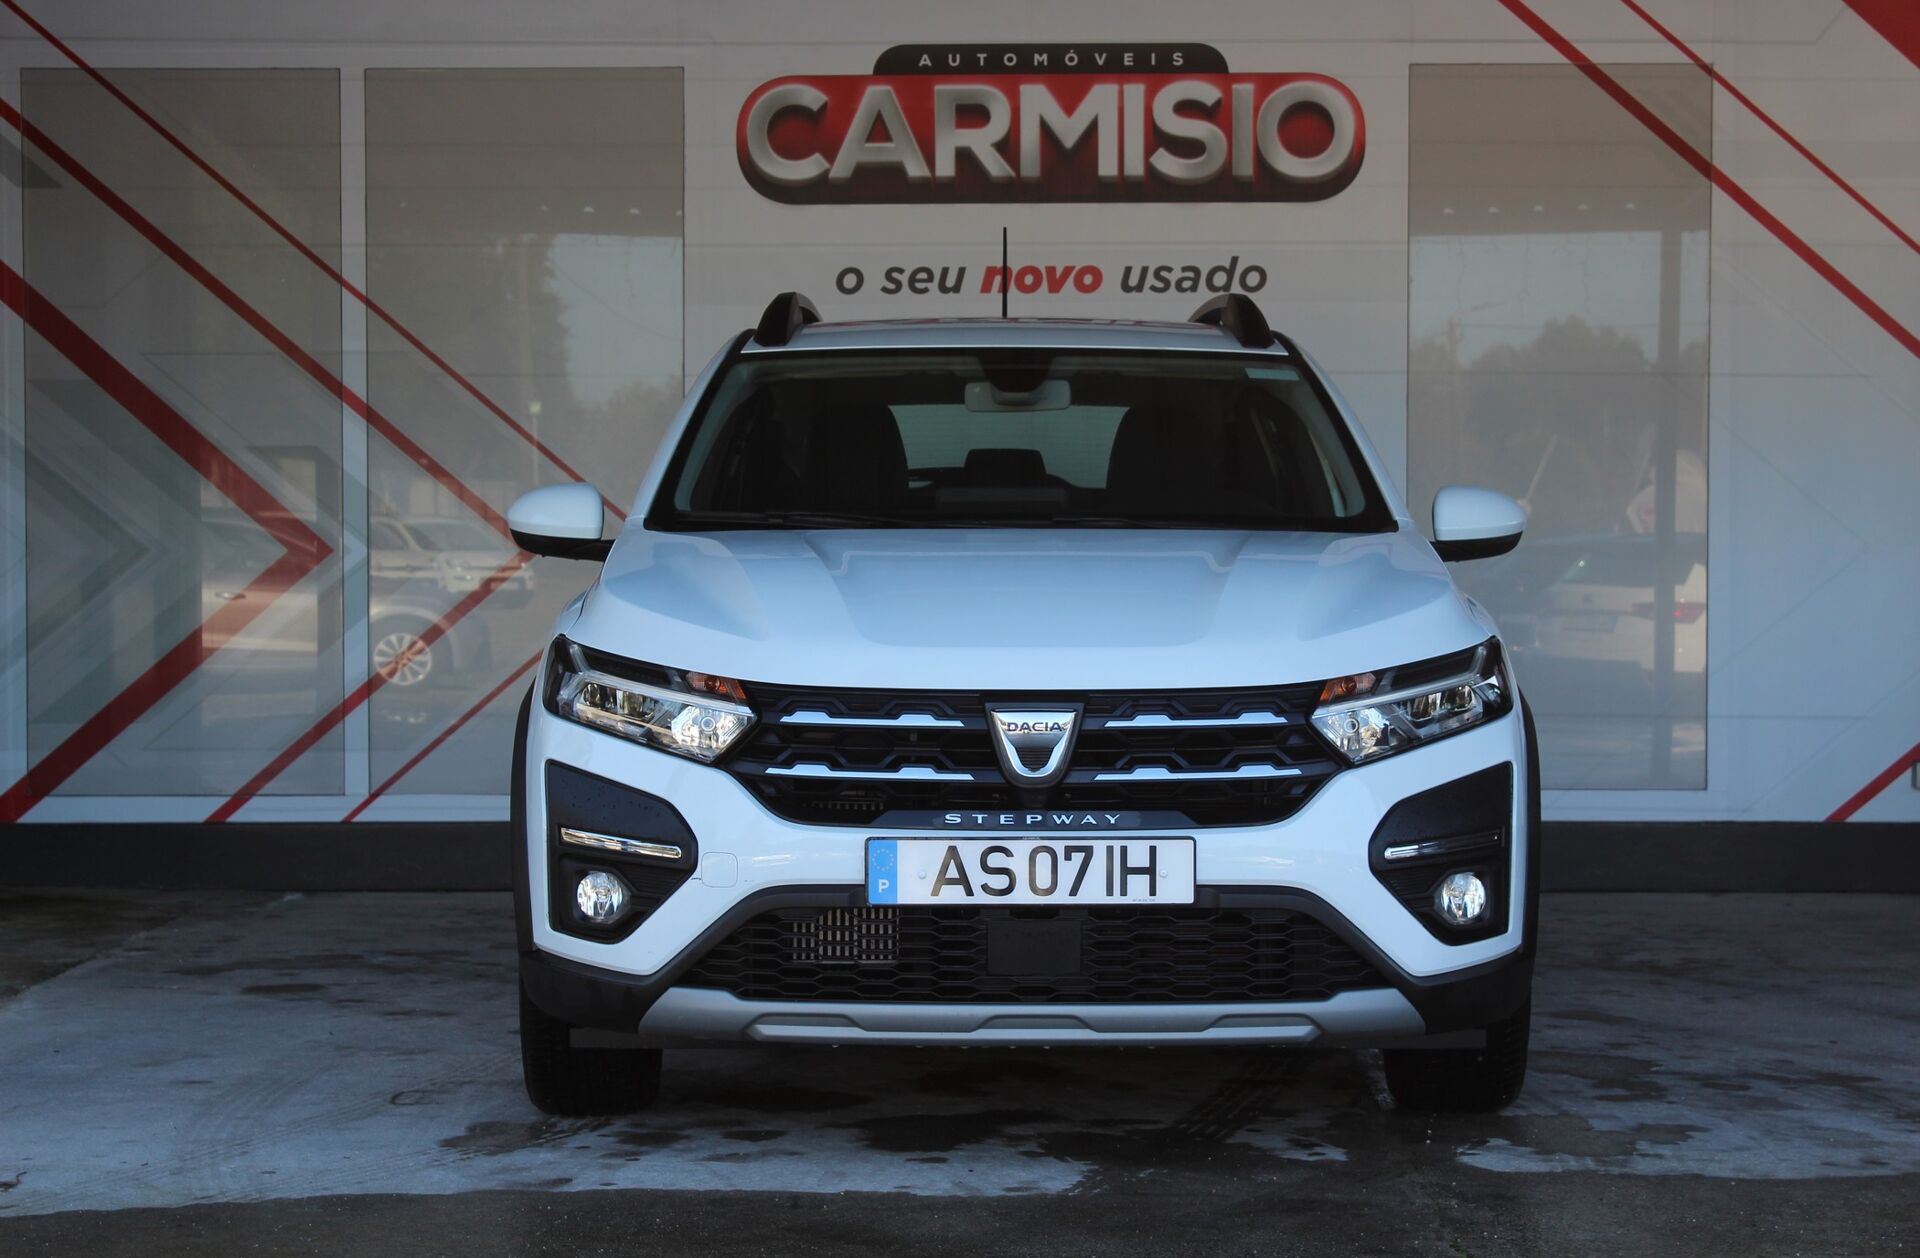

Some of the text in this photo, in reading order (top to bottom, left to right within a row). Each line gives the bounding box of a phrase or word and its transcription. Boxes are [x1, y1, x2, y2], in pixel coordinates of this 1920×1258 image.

[918, 48, 1185, 67] AUTOMÓVEIS
[746, 81, 1356, 184] CARMISIO
[835, 256, 1268, 295] o seu novo usado
[1006, 721, 1063, 733] DACIA
[944, 813, 1121, 826] STEPWAY
[878, 879, 890, 893] P
